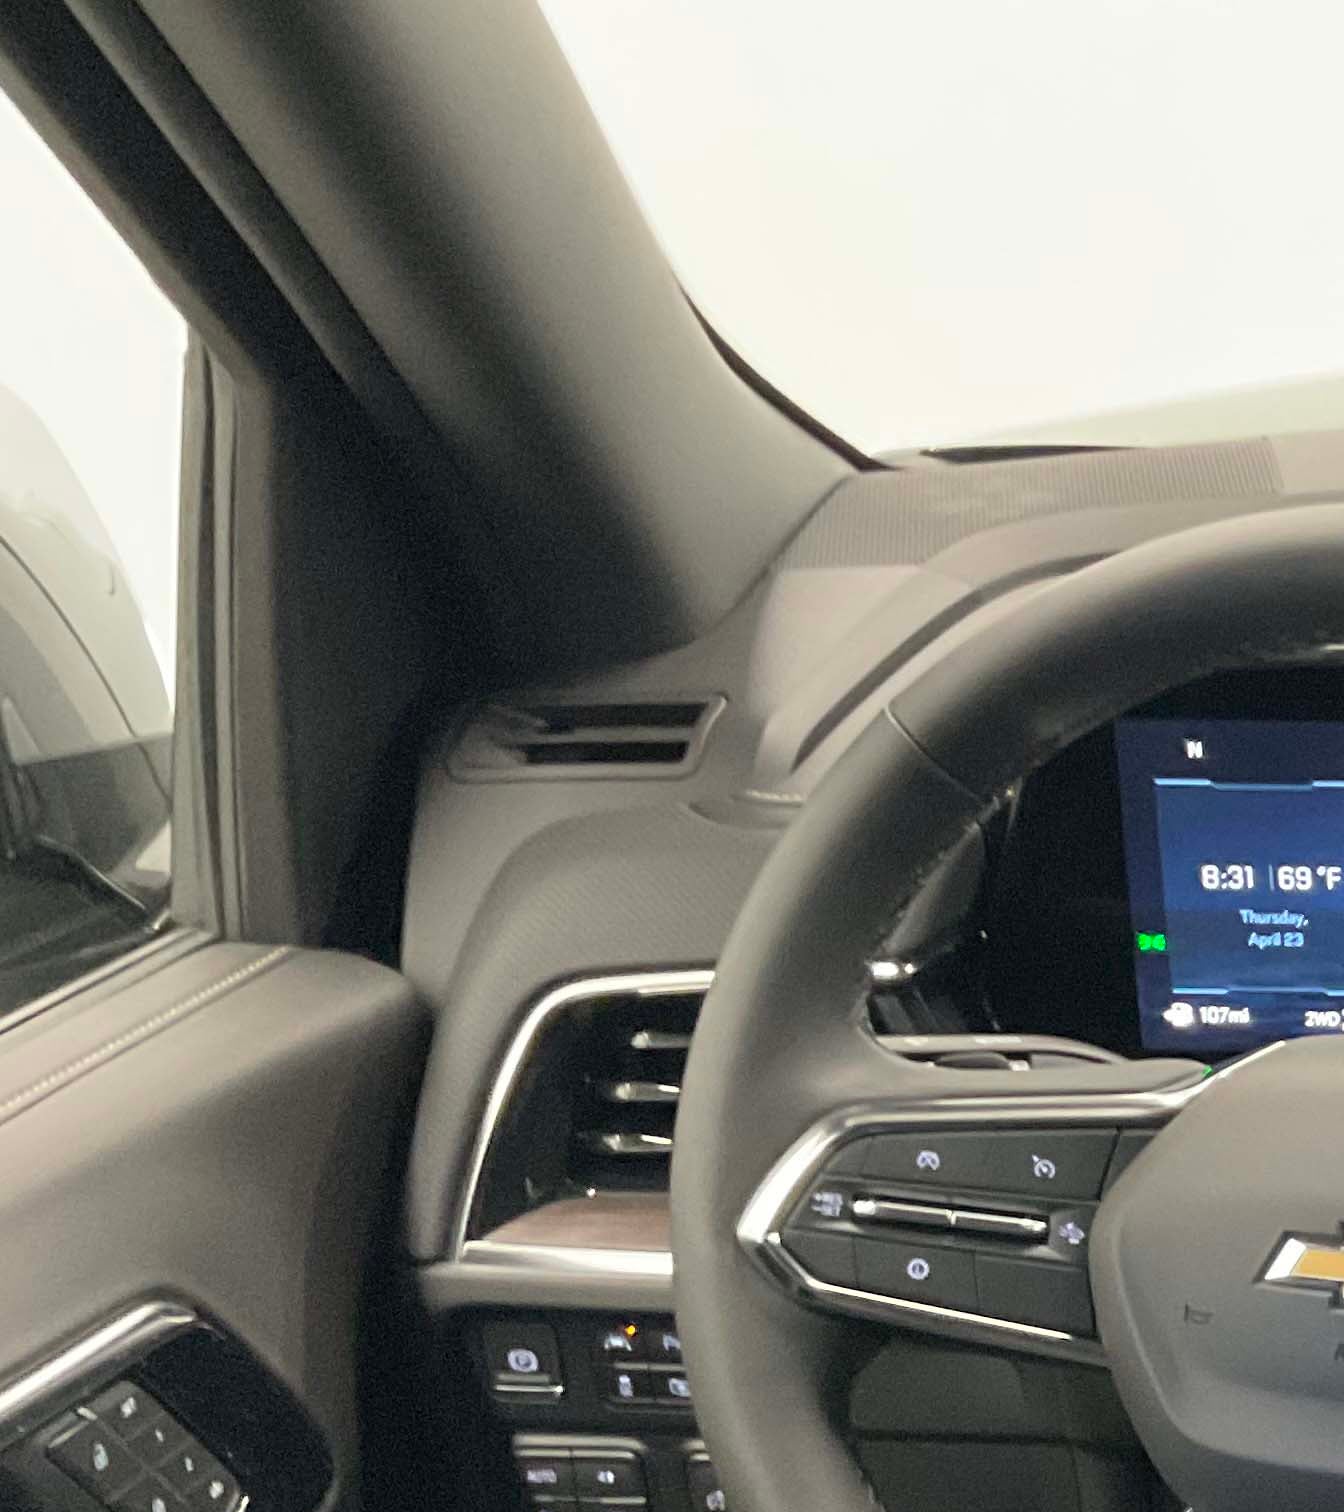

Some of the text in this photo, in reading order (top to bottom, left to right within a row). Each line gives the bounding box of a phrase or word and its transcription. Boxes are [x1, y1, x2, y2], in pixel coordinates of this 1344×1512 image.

[1200, 865, 1254, 889] 8:31
[1239, 909, 1309, 927] Thursday,
[1247, 932, 1304, 950] April 23
[1304, 1010, 1341, 1028] 2WD
